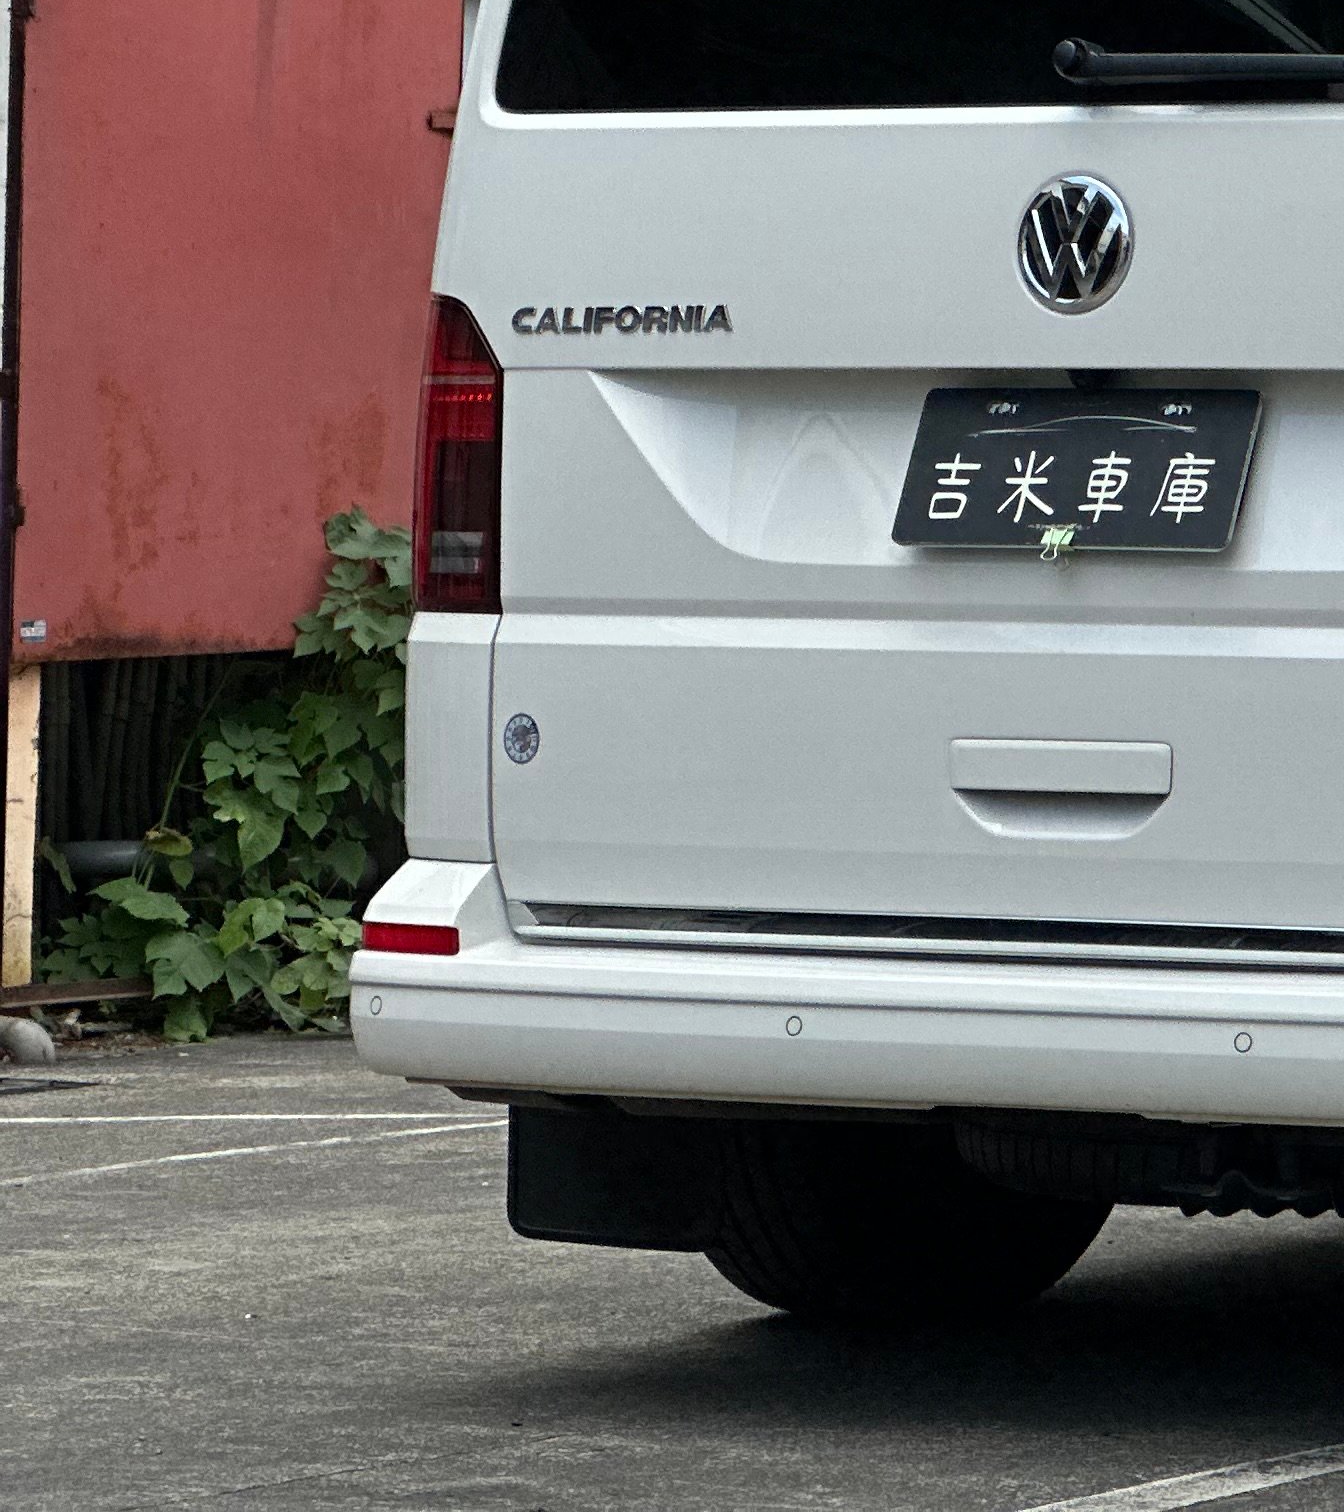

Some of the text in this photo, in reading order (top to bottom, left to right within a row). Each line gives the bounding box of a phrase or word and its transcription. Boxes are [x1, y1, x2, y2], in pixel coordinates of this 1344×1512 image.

[510, 303, 734, 336] CALIFORNIA
[927, 450, 1218, 524] 吉米車庫
